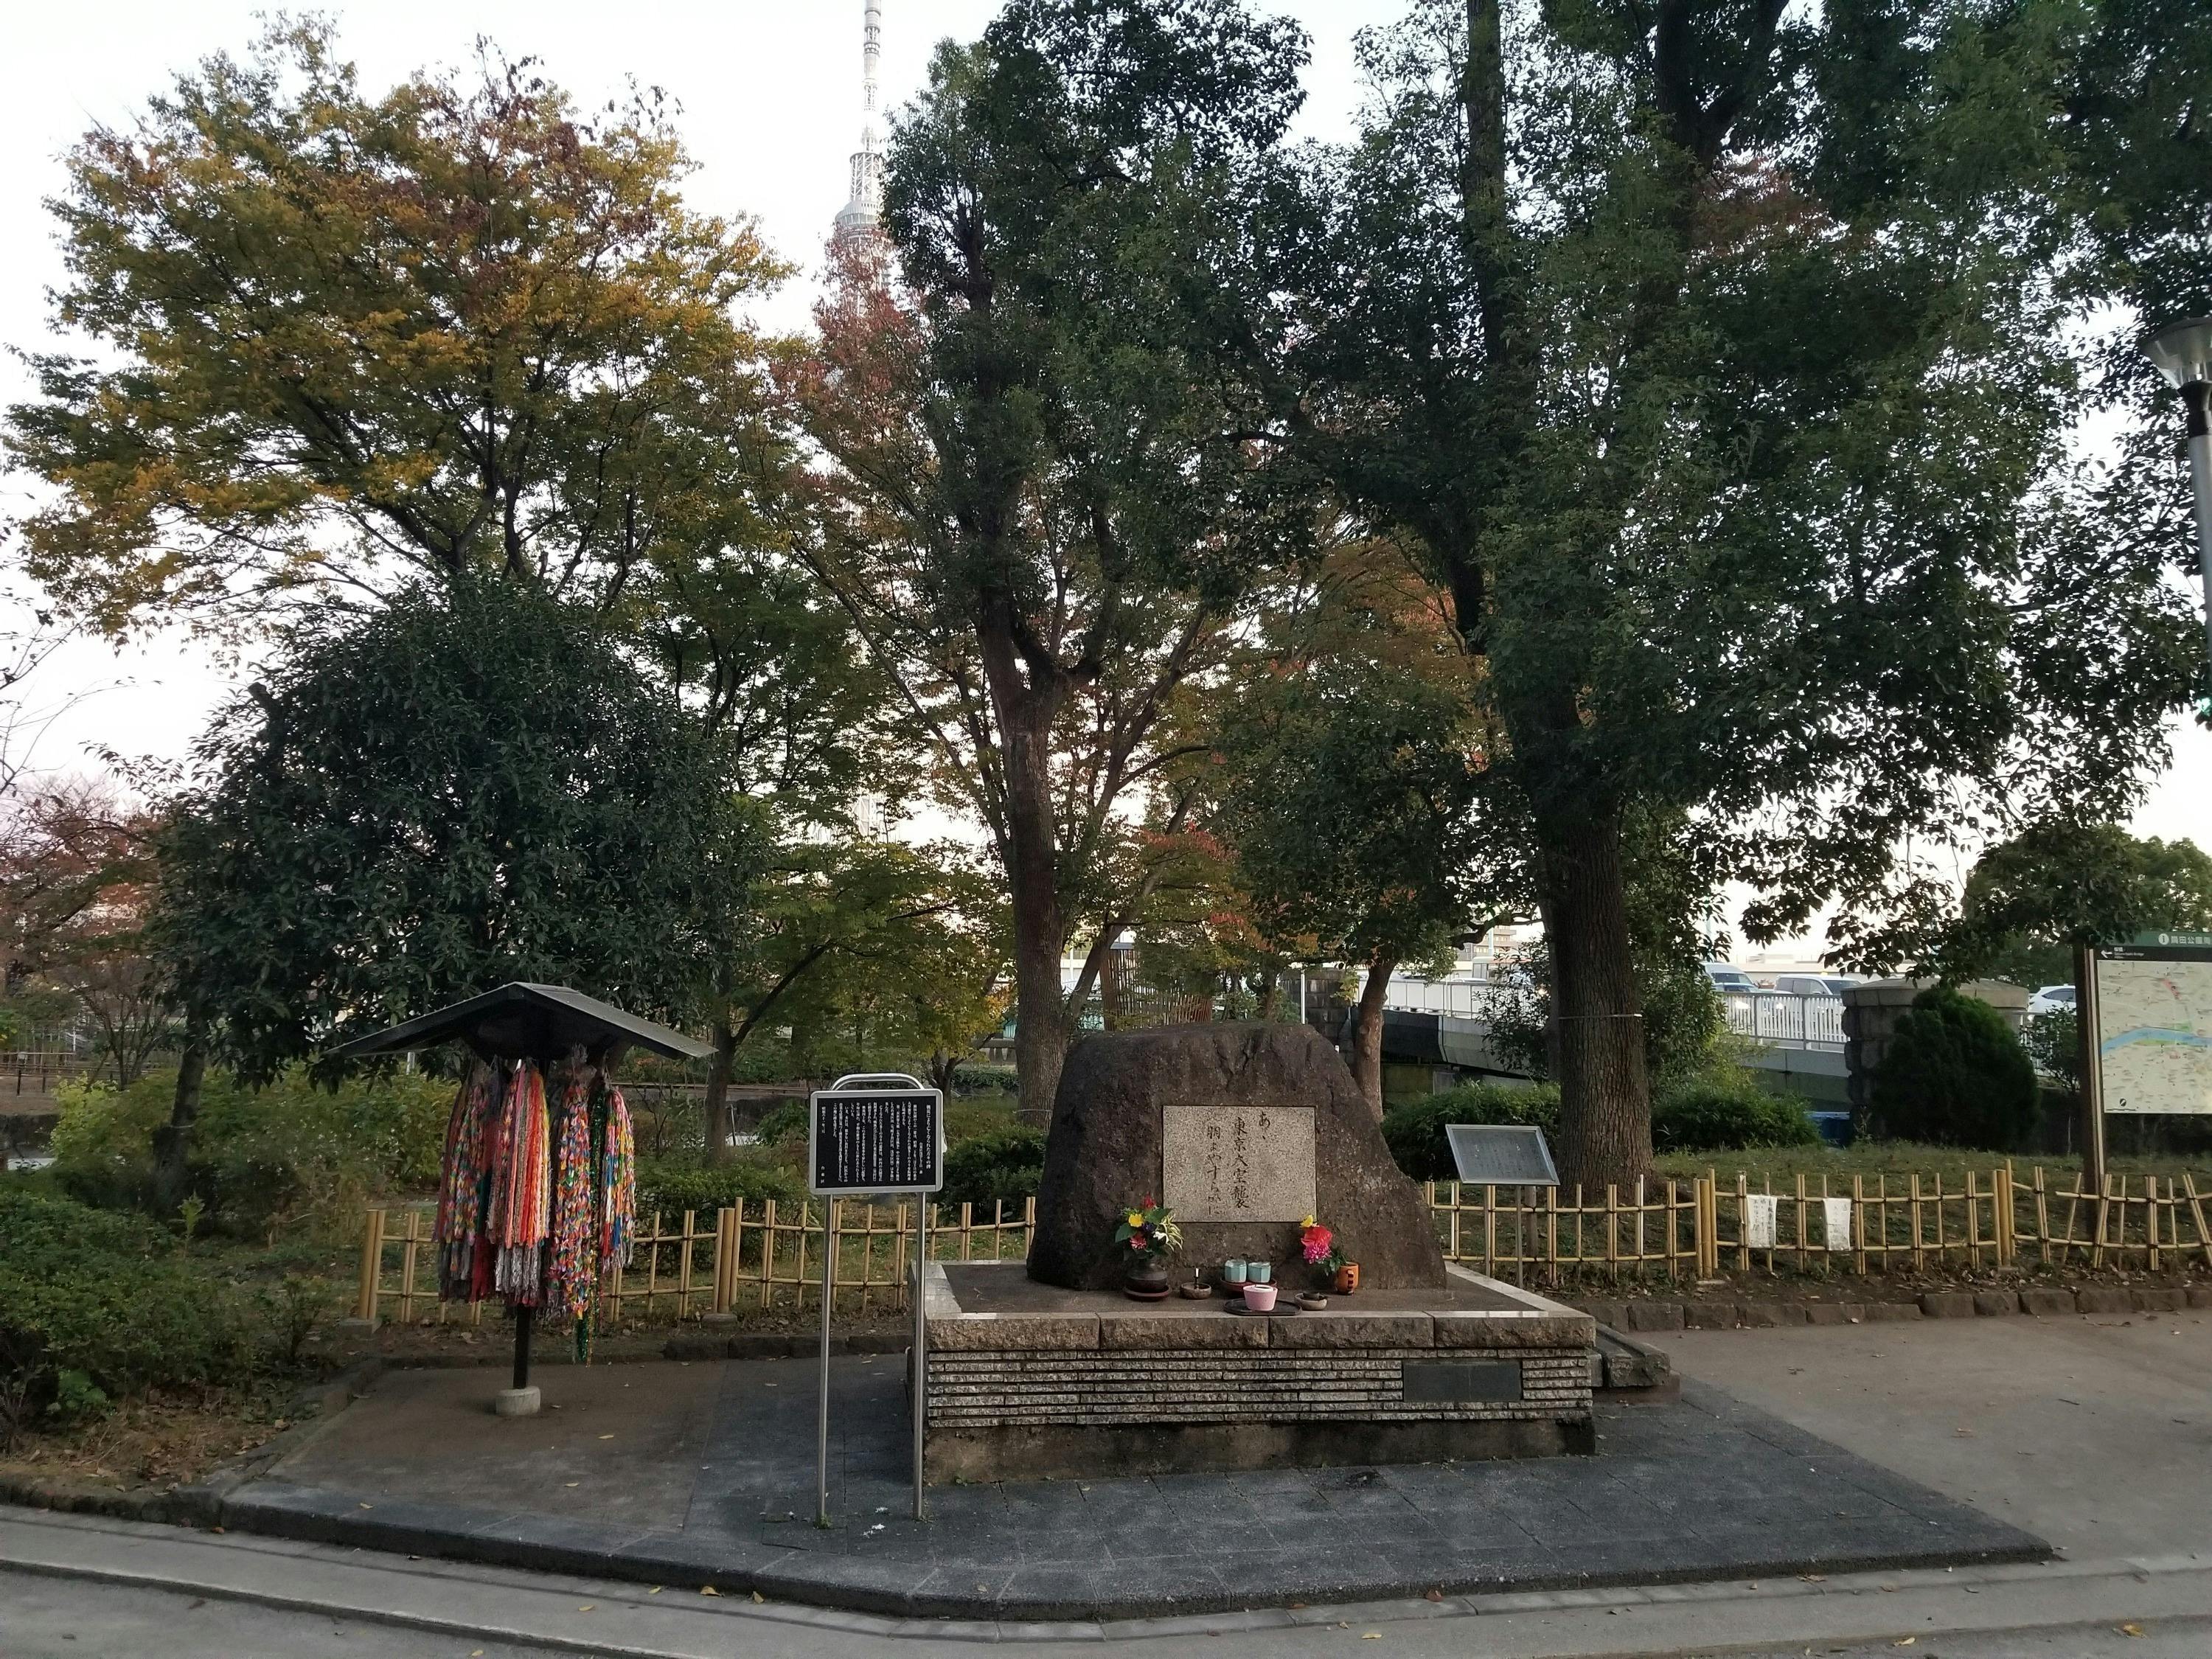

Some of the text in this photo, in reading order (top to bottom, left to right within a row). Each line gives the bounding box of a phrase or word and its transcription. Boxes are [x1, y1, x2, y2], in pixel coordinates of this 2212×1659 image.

[1230, 1116, 1250, 1208] 東京大空襲
